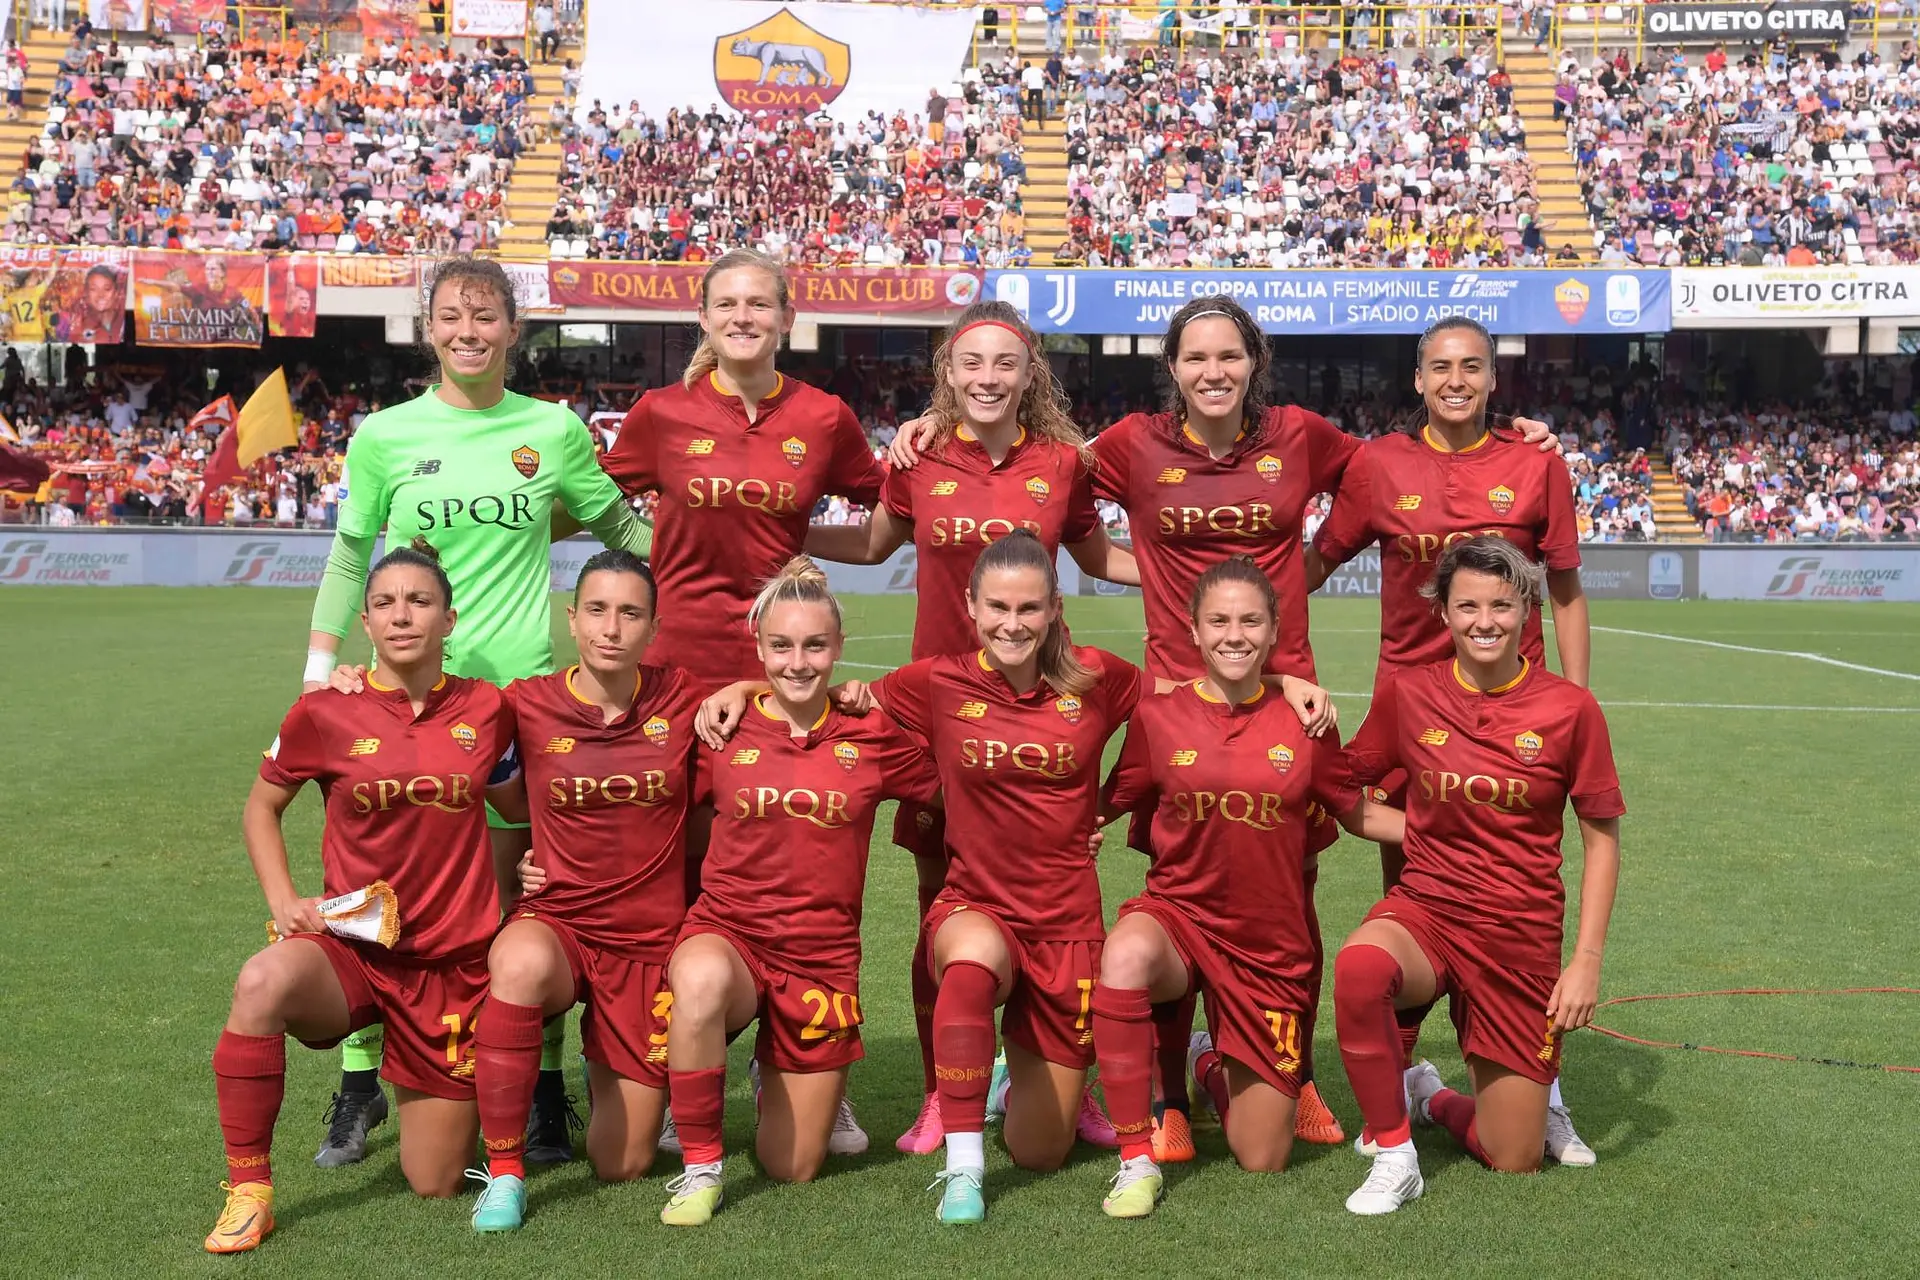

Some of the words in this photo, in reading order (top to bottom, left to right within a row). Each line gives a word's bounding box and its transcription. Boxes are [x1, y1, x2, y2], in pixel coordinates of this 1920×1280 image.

[1650, 11, 1763, 33] OLIVETO
[1767, 9, 1845, 31] CITRA
[732, 88, 824, 105] ROMA
[591, 271, 680, 300] ROMA
[806, 277, 859, 301] FAN
[866, 277, 936, 302] CLUB
[1115, 280, 1185, 298] FINALE
[1191, 280, 1258, 298] COPPA
[1264, 280, 1327, 298] ITALIA
[1333, 280, 1439, 298] FEMMINILE
[1713, 283, 1822, 302] OLIVETO
[1832, 282, 1908, 301] CITRA
[14, 301, 35, 323] 12
[1257, 304, 1316, 322] ROMA
[1347, 304, 1419, 322] STADIO
[1424, 304, 1498, 322] ARECHI
[687, 477, 800, 518] SPQR
[417, 493, 535, 531] SPQR
[1160, 503, 1279, 538] SPQR
[43, 552, 130, 565] FERROVIE
[1398, 529, 1504, 563] SP
[275, 555, 329, 566] FERR
[35, 569, 112, 581] ITALIANE
[269, 571, 323, 583] ITALIA
[1819, 568, 1904, 581] FERROVIE
[1810, 585, 1885, 597] ITALIANE
[961, 738, 1079, 779] SPQR
[352, 774, 475, 813] SPQR
[550, 769, 674, 807] SPQR
[1420, 770, 1534, 814] SPQR
[734, 787, 852, 829] SPQR
[1174, 790, 1287, 831] SPQR
[649, 991, 674, 1045] 3
[801, 988, 860, 1040] 20
[442, 1012, 476, 1062] 1
